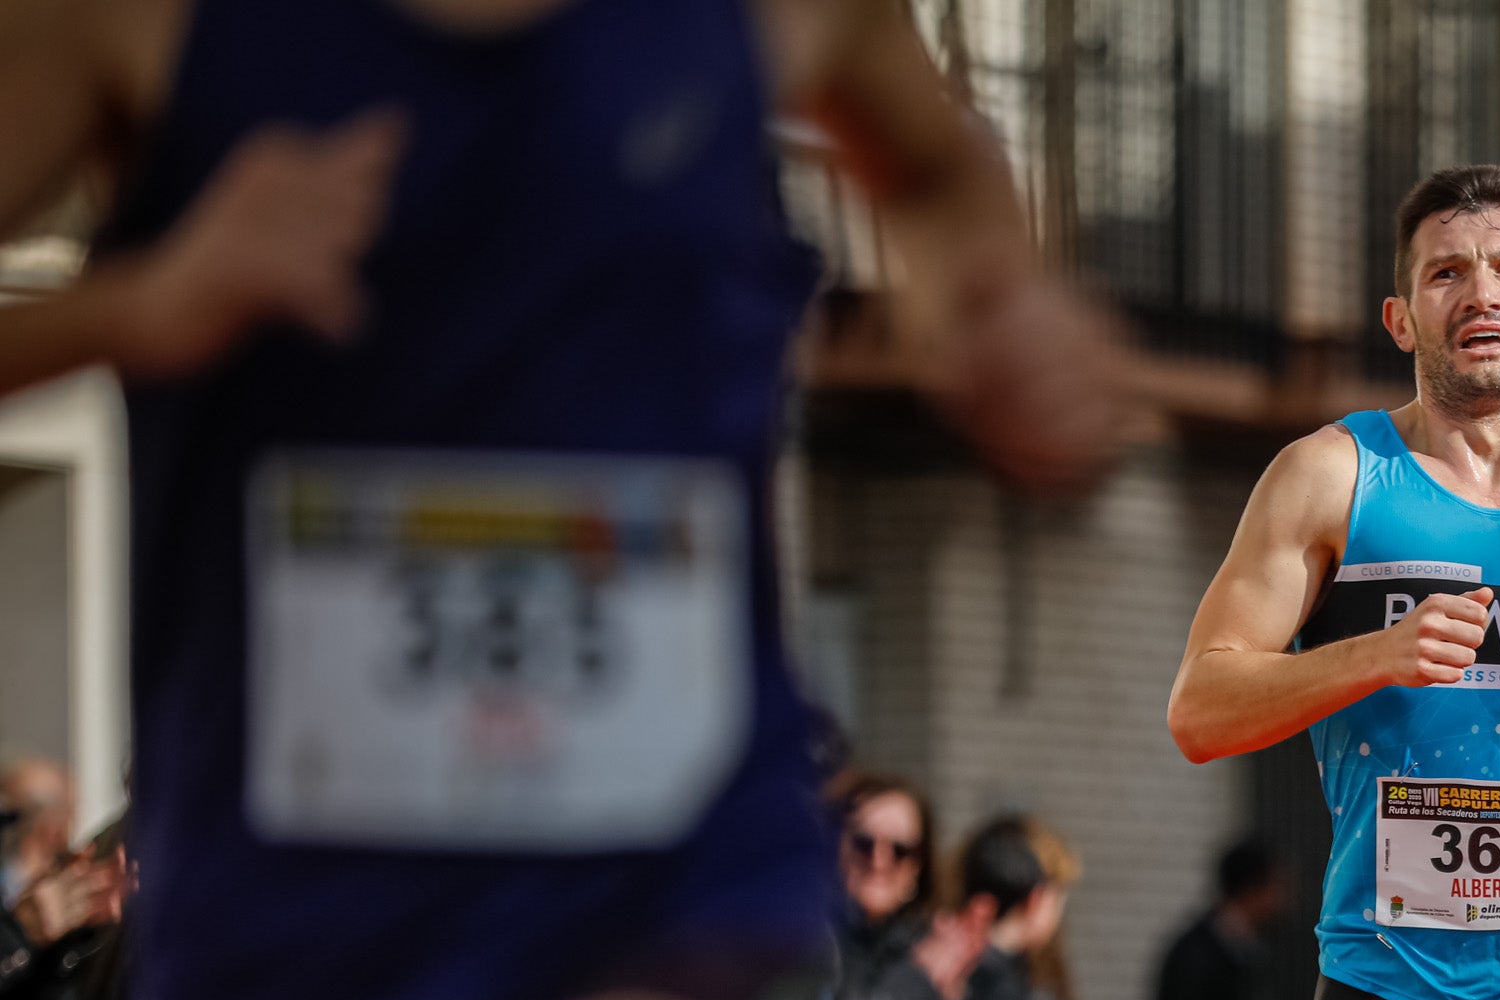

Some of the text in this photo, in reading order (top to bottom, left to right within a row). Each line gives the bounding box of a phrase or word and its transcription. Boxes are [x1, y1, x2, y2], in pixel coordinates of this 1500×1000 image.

[1361, 564, 1471, 578] CLUB DEPORTIVO
[1388, 786, 1408, 800] 26
[1422, 787, 1439, 807] VII
[1388, 805, 1479, 819] Ruta de los Secaderos
